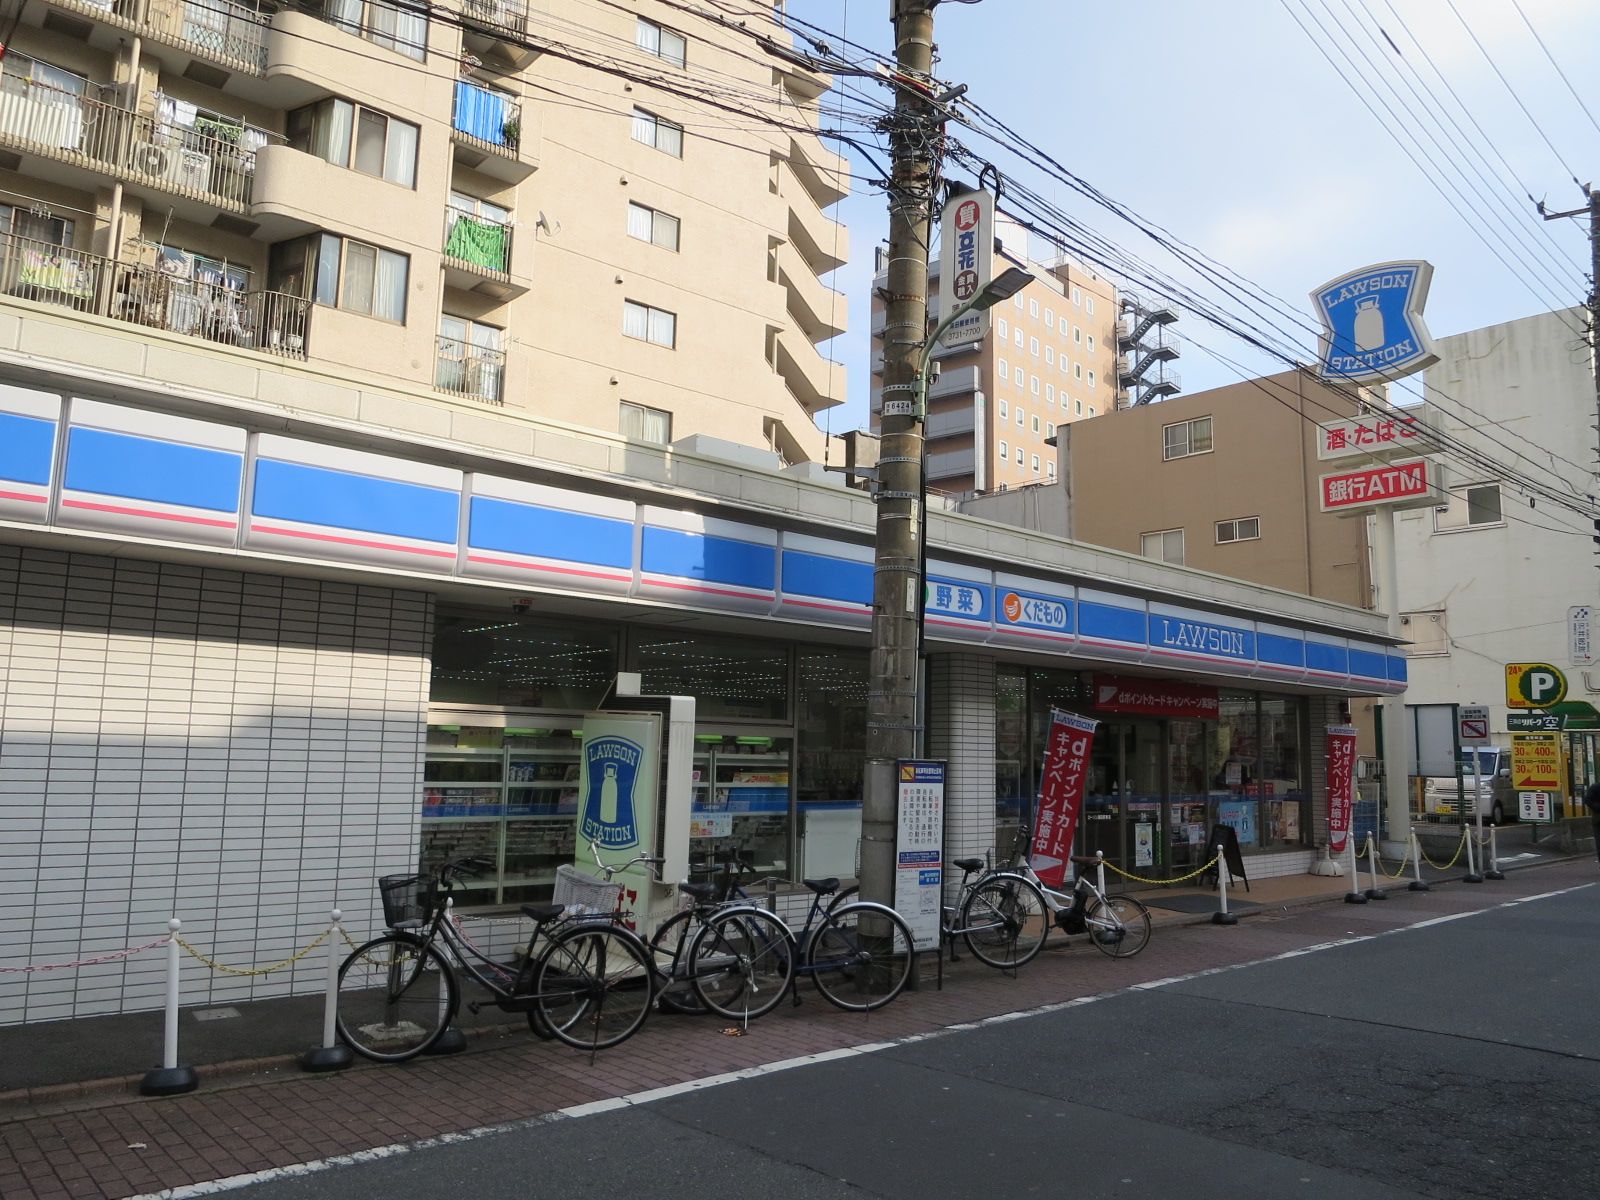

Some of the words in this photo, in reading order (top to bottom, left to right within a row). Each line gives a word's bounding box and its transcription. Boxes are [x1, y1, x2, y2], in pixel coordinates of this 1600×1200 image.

[959, 205, 976, 228] 質
[958, 231, 975, 269] 立花
[1325, 275, 1409, 308] LAWSON
[1331, 339, 1413, 371] STATION
[891, 402, 909, 410] 6424
[1326, 418, 1417, 450] 酒・たばこ
[1329, 468, 1421, 502] 銀行ATM
[936, 585, 974, 612] 野菜
[1023, 600, 1063, 625] くだもの
[1163, 620, 1244, 655] LAWSON
[1531, 672, 1554, 700] P
[1056, 713, 1094, 730] LAWSON
[1543, 715, 1559, 730] 空
[590, 744, 636, 767] LAWSON
[1036, 732, 1070, 852] キャンペーン実施中
[1052, 737, 1087, 856] dポイントカード
[1330, 739, 1342, 829] キャンペーン実施中
[585, 818, 631, 842] STATION
